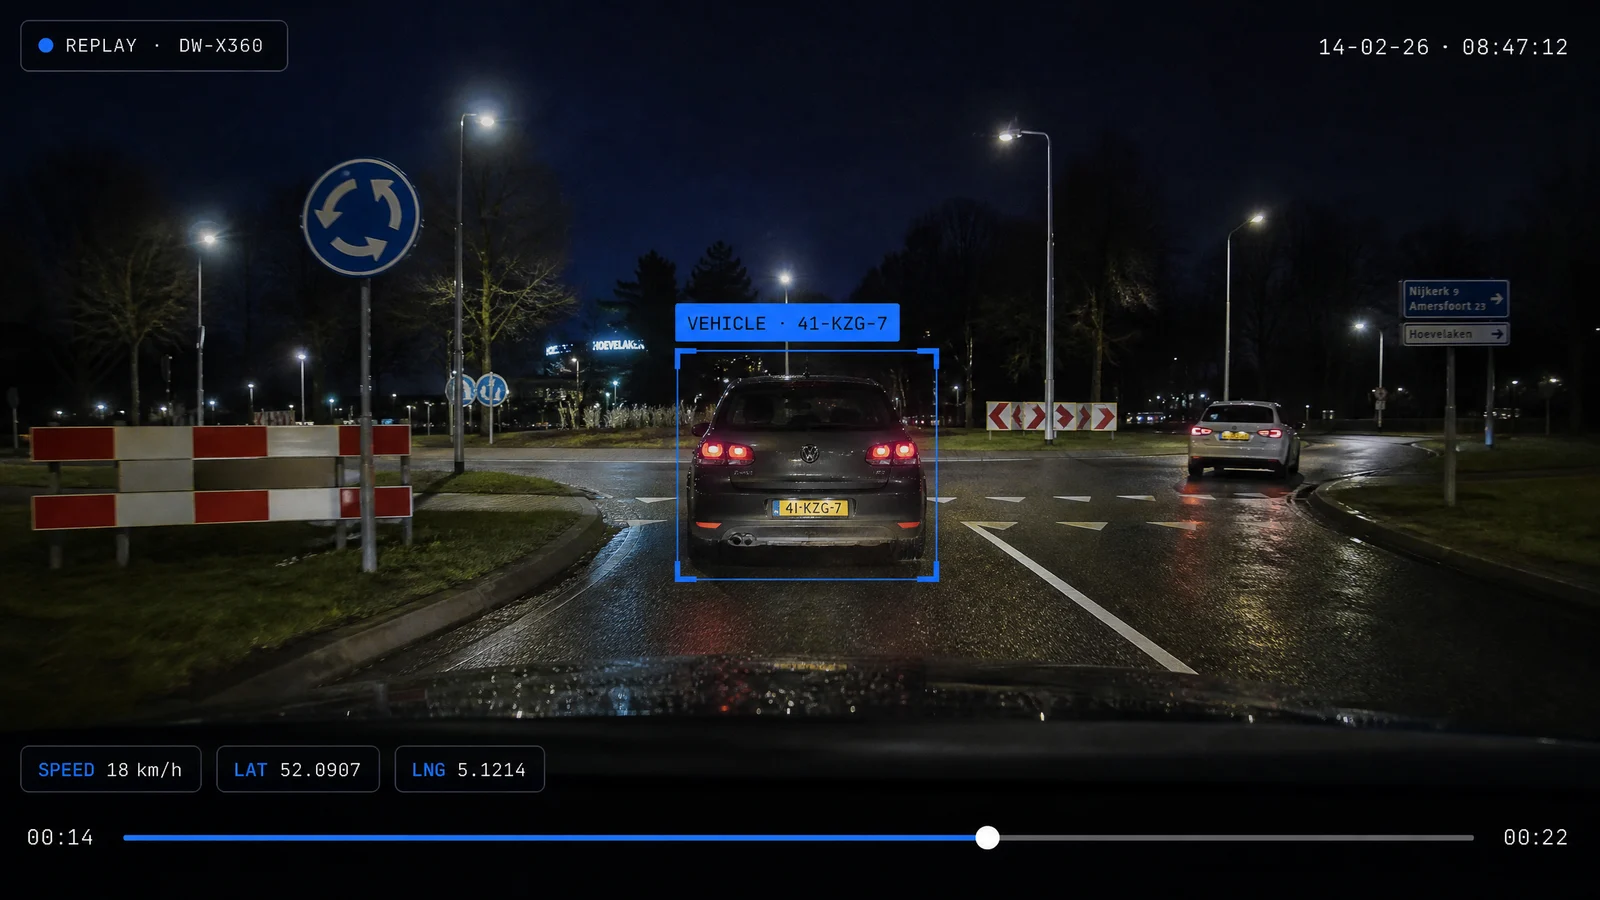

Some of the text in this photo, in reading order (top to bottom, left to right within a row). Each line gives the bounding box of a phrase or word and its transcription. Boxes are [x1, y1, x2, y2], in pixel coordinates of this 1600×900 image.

[1409, 286, 1460, 298] Nijkerk 9
[1409, 300, 1487, 311] Amersfoort 23
[1409, 329, 1473, 339] Hoevelaken
[785, 502, 842, 514] 41-KZG-7
